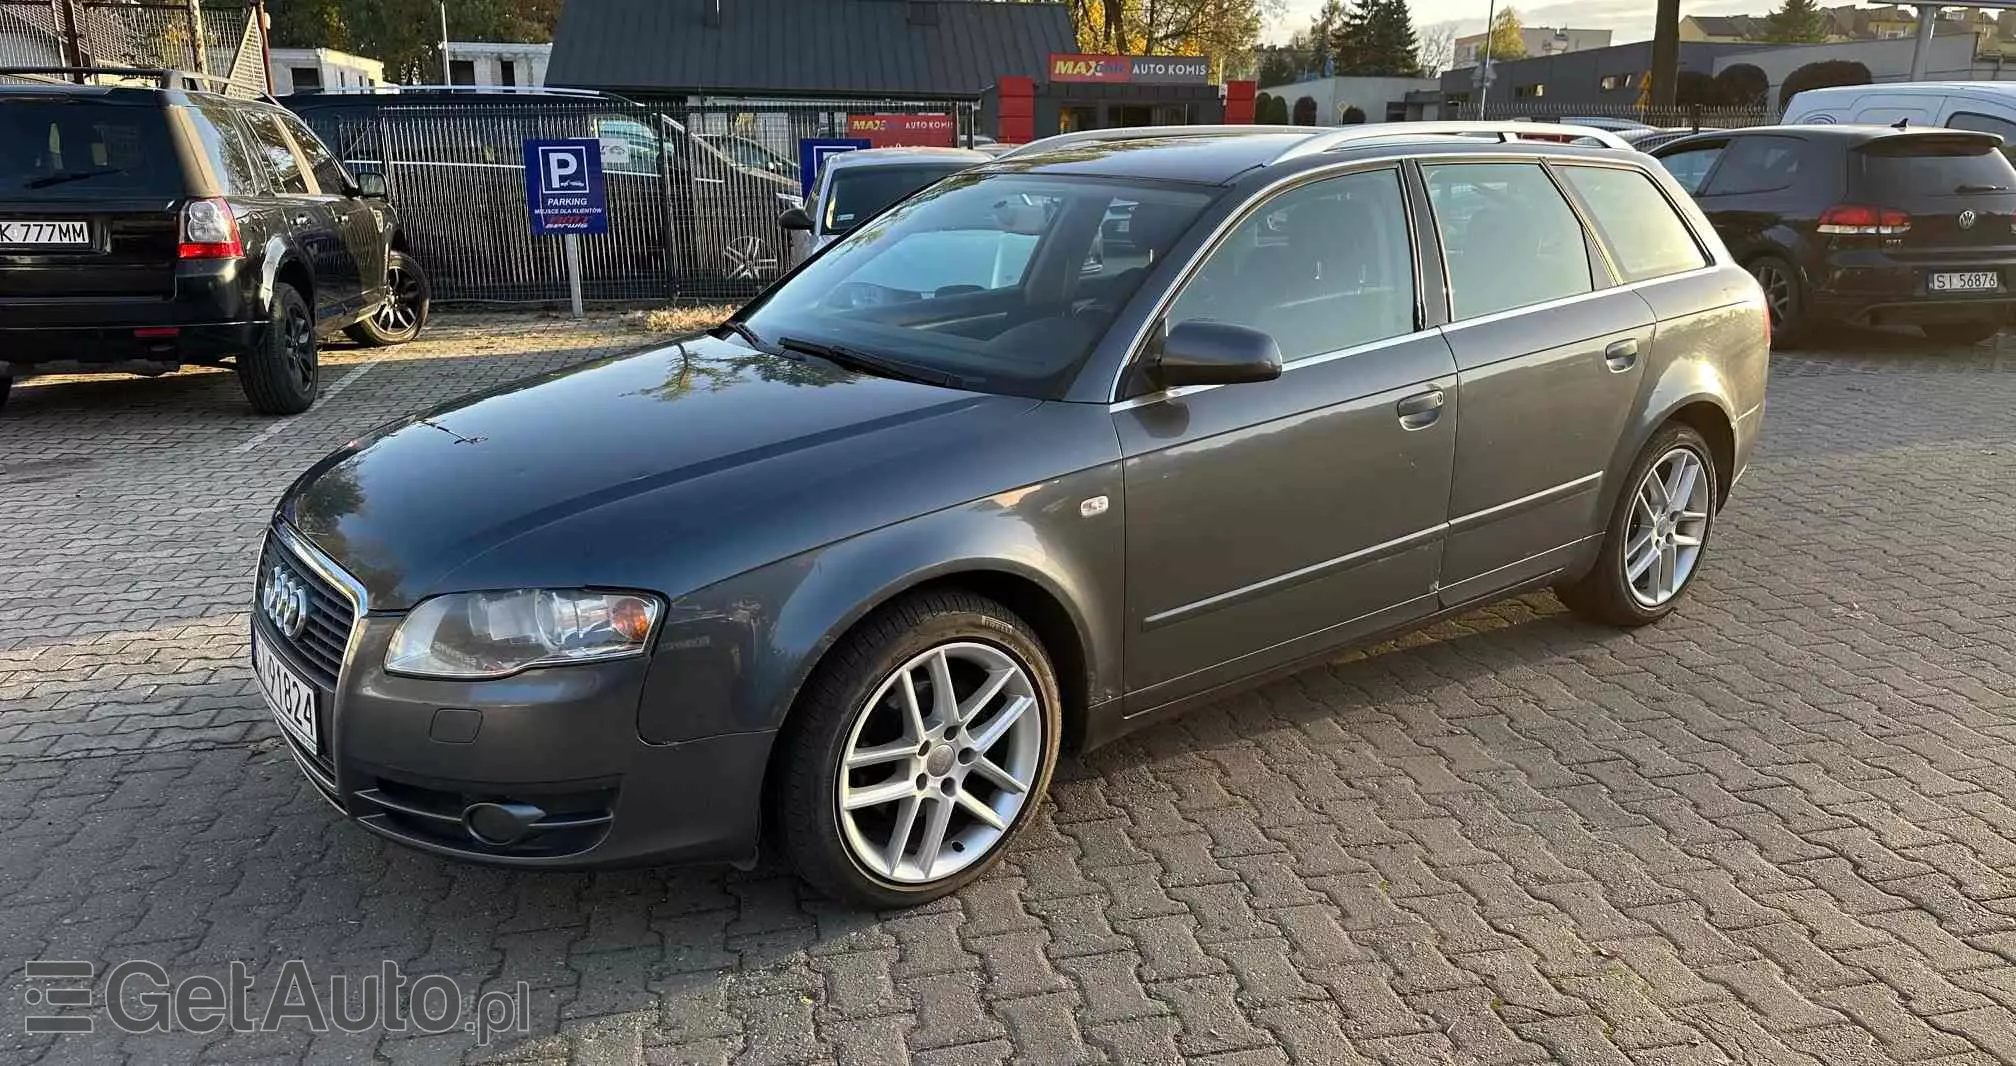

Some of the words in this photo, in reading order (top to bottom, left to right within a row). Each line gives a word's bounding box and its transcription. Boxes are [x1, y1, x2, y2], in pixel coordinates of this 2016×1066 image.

[1132, 63, 1165, 75] AUTO
[1168, 63, 1206, 76] KOMIS
[905, 121, 927, 129] AUTO
[549, 153, 577, 188] P
[547, 198, 588, 206] PARKING
[0, 224, 13, 242] K
[20, 224, 86, 242] 777MM
[1936, 274, 1953, 289] SI
[1959, 273, 1996, 288] 56876
[268, 653, 314, 736] 91824
